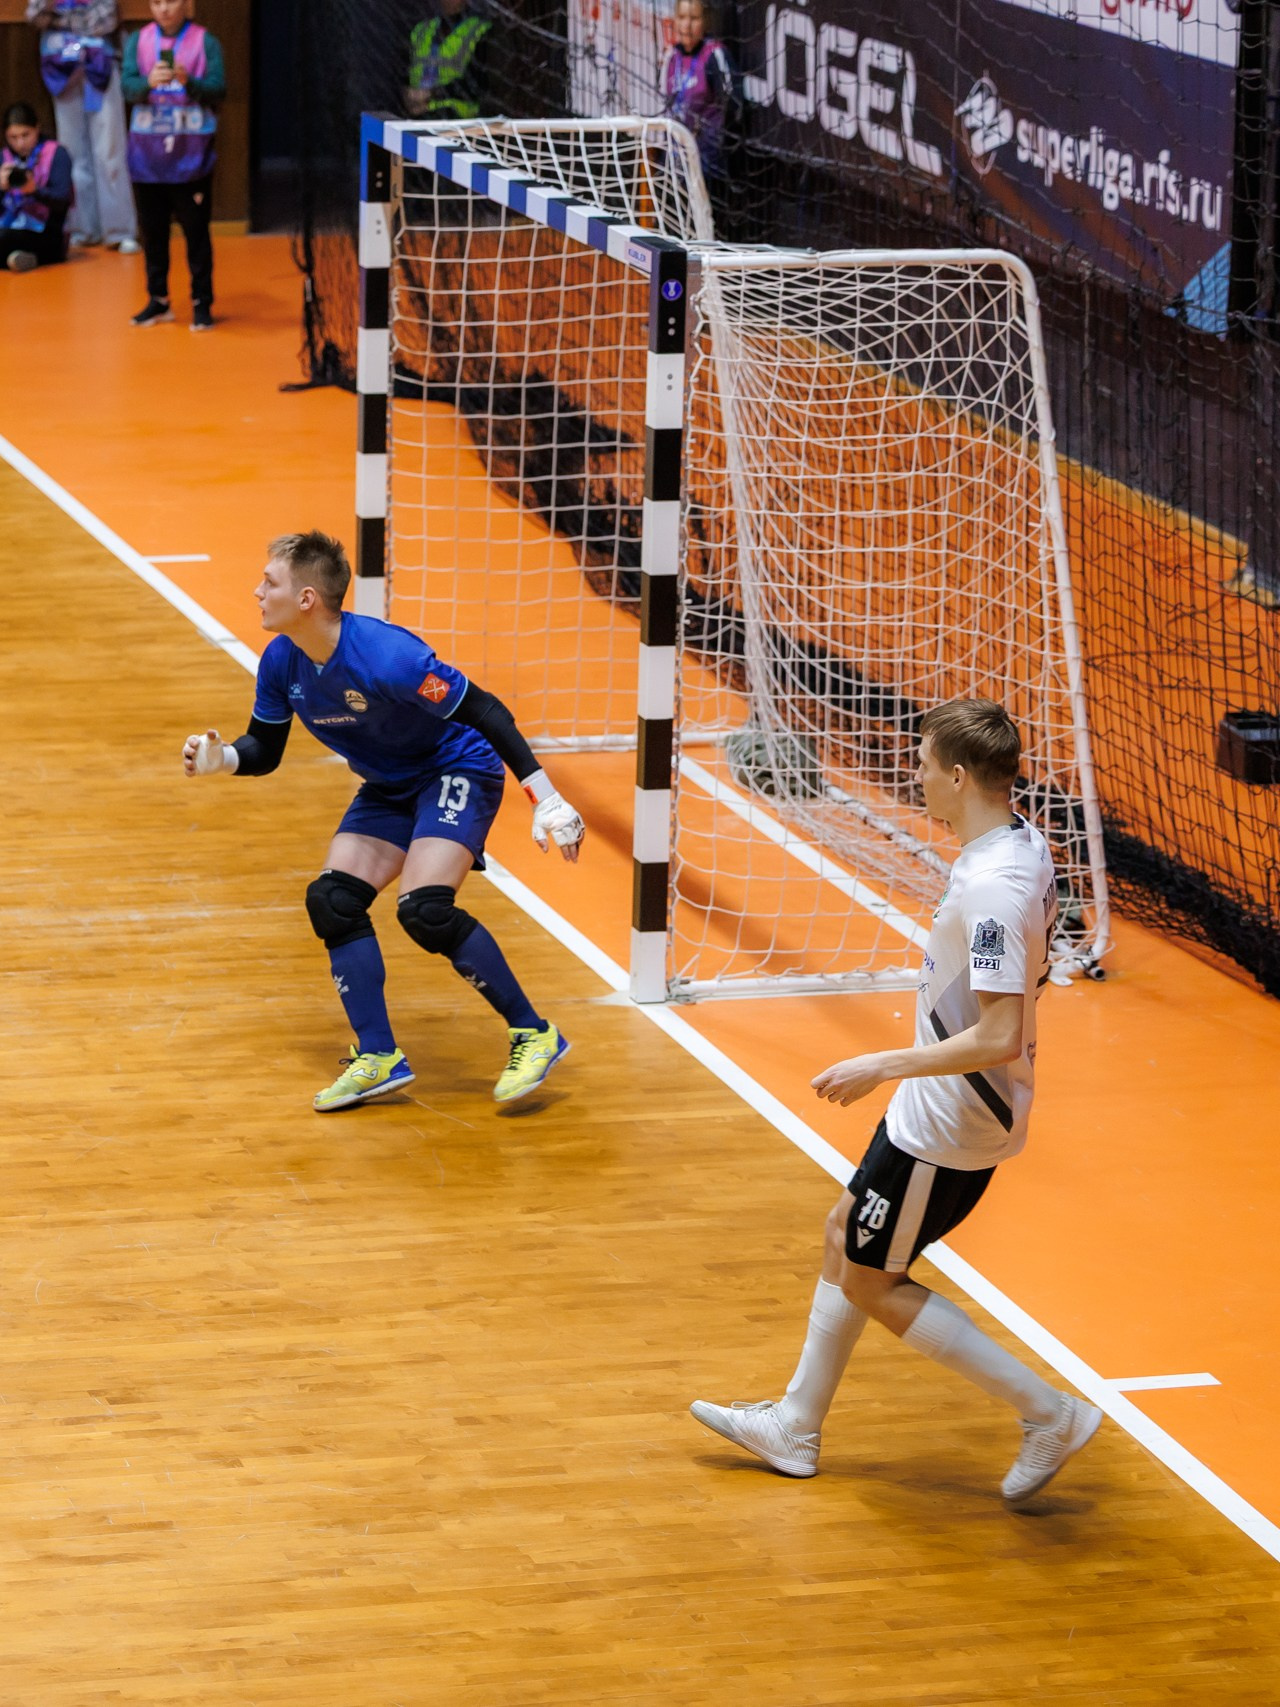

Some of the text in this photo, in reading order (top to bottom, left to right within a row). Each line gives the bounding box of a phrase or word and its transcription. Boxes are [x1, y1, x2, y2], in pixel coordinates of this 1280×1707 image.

[1017, 118, 1222, 231] superliga.rfs.ru
[437, 774, 471, 812] 13
[975, 958, 1000, 970] 1221
[858, 1187, 891, 1230] 78
